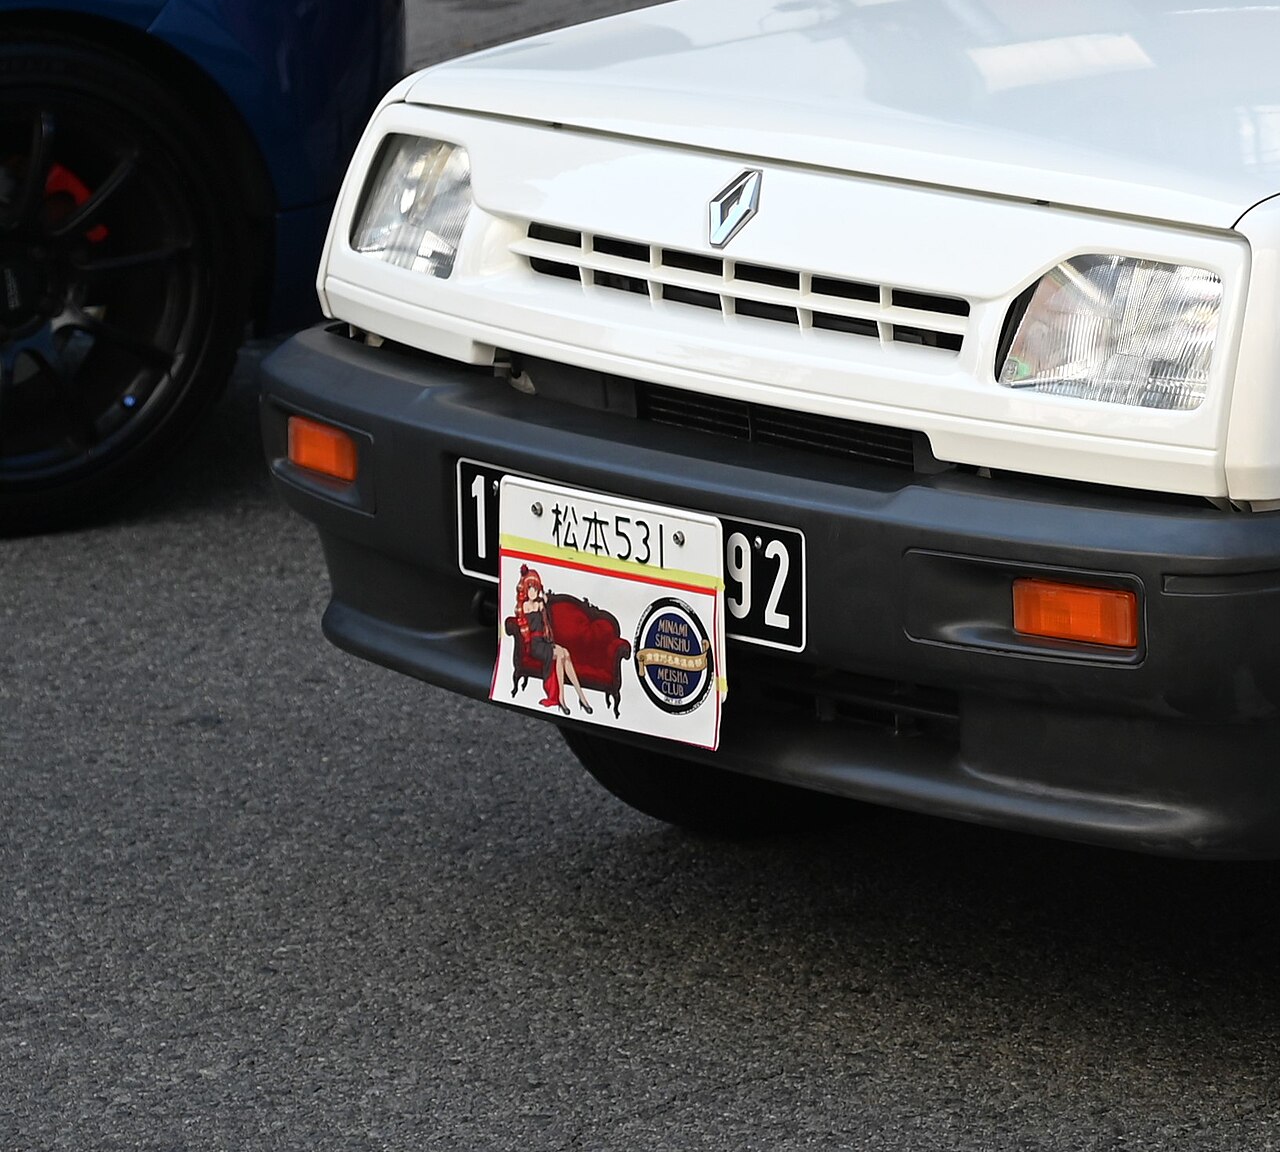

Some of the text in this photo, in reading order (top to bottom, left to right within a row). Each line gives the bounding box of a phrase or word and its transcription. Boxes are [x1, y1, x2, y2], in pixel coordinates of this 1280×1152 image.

[657, 618, 688, 637] MINAMI
[655, 633, 691, 653] SHINSHU
[657, 668, 689, 685] MEISHA
[661, 682, 685, 697] CLUB
